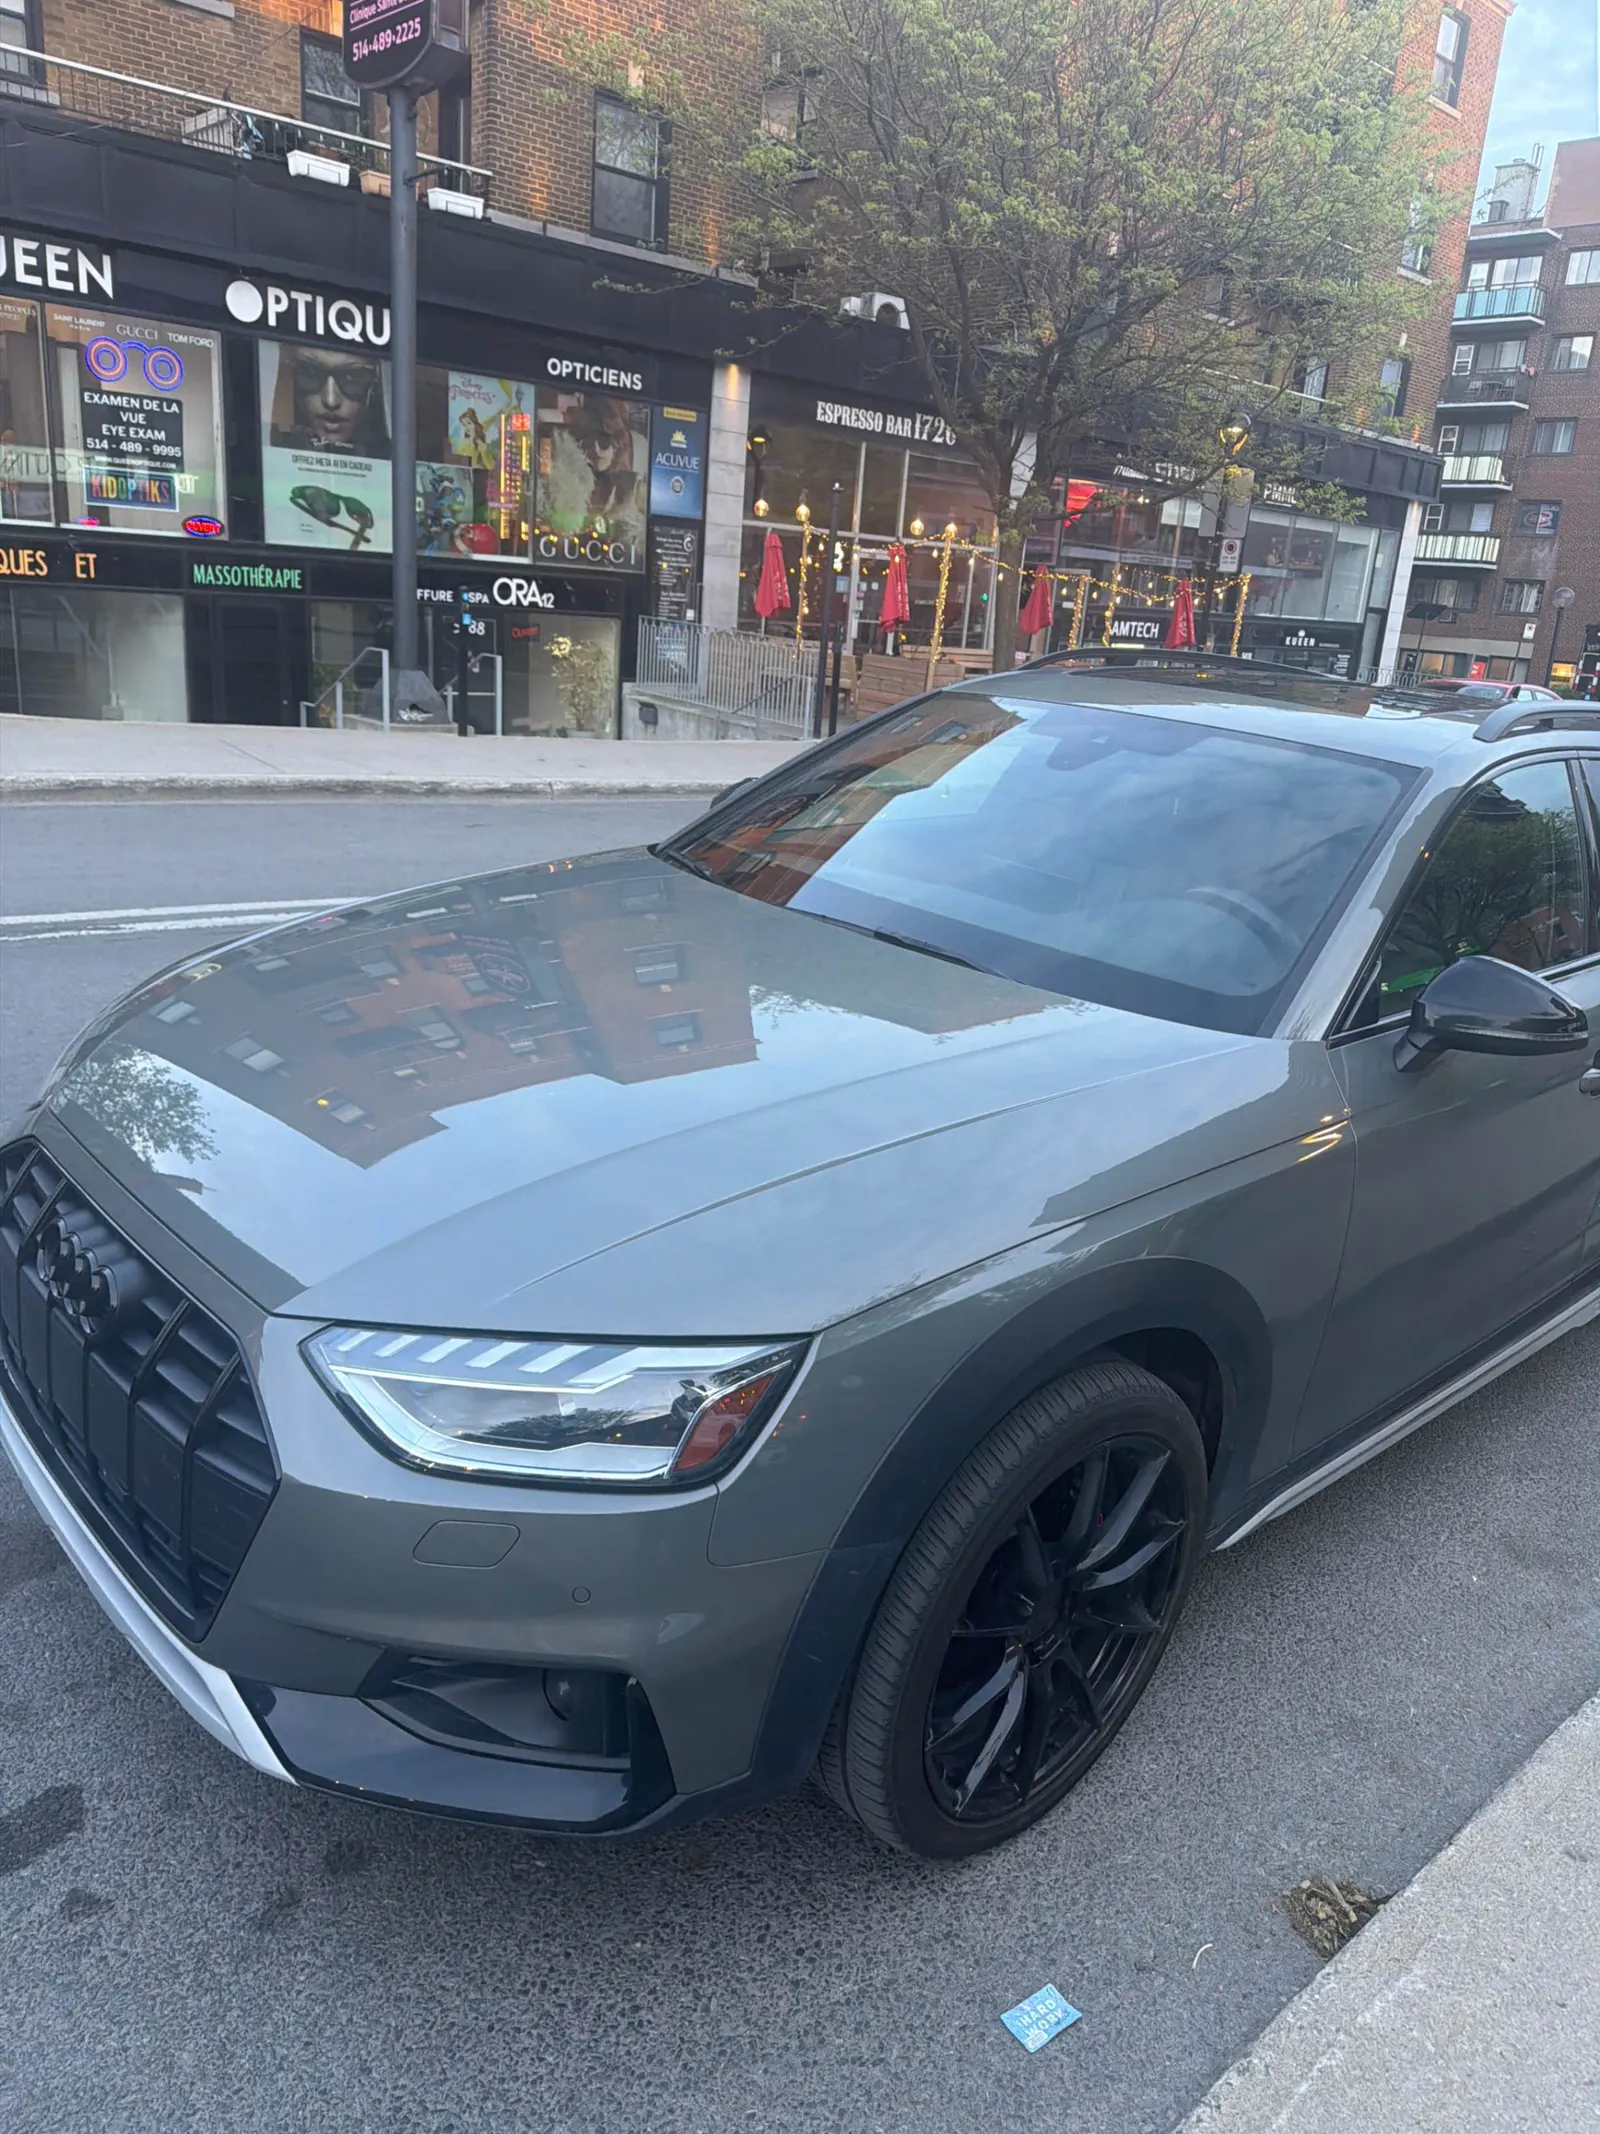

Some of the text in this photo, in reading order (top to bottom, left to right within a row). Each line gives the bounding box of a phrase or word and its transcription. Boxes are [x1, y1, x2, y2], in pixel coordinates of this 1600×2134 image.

[350, 4, 377, 24] Clinique
[116, 324, 158, 340] GUCCI
[167, 332, 214, 348] TOM FORD
[547, 358, 643, 391] OPTICIENS
[84, 392, 180, 414] EXAMEN DE LA
[120, 411, 147, 425] VUE
[816, 401, 883, 433] ESPRESSO
[886, 414, 912, 439] BAR
[101, 424, 166, 441] EYE EXAM
[86, 438, 109, 450] 514
[120, 441, 142, 453] 489
[152, 444, 182, 457] 9995
[292, 454, 313, 466] OFFREZ
[315, 456, 332, 468] META
[349, 461, 372, 473] CADEAU
[655, 452, 700, 470] ACUVUE
[90, 473, 170, 503] KIDOPTIKS
[540, 535, 636, 565] GUCCI
[75, 552, 97, 579] ET
[193, 563, 303, 589] MASSOTHÉRAPIE
[1111, 620, 1159, 639] AMTECH
[1285, 636, 1316, 648] KUEEN
[1018, 1999, 1057, 2028] HARD
[1025, 2008, 1064, 2037] WORK
